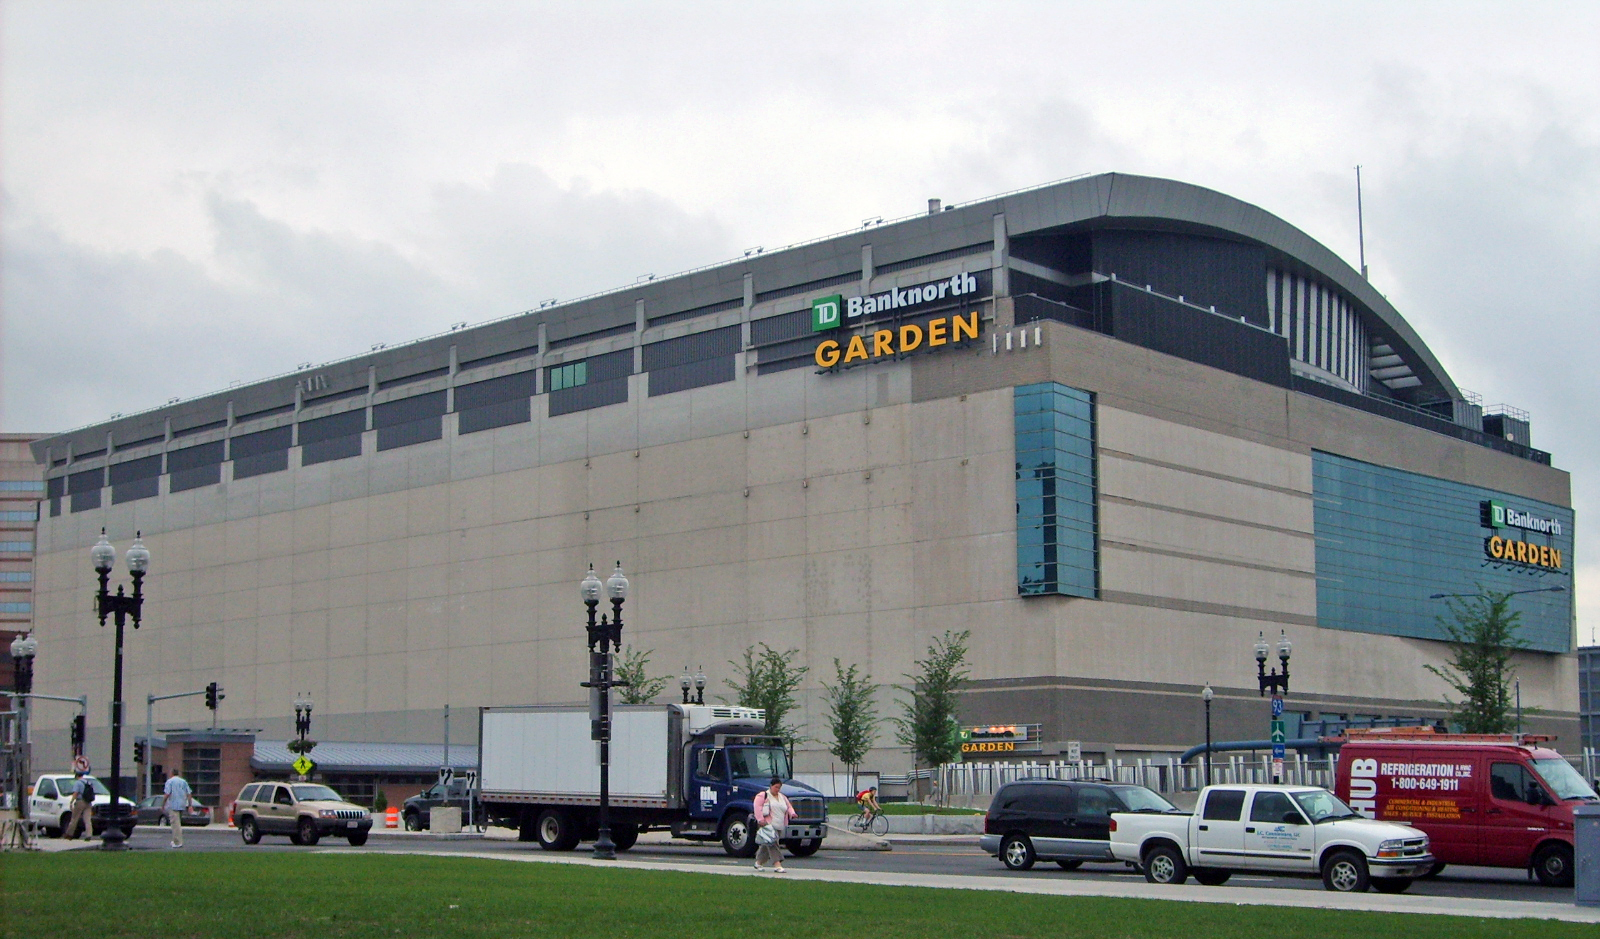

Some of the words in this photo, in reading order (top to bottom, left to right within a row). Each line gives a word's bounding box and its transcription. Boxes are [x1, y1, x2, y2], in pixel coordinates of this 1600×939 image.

[815, 302, 837, 324] TD
[848, 272, 976, 317] Banknorth
[815, 312, 978, 367] GARDEN
[1492, 505, 1504, 522] TD
[1507, 508, 1561, 535] Banknorth
[1490, 536, 1561, 568] GARDEN
[1273, 700, 1282, 713] 93
[961, 742, 1014, 752] GARDEN
[1381, 763, 1454, 776] REFRIGERATION
[1391, 777, 1459, 790] 1-800-649-1911
[1350, 758, 1377, 819] HUB
